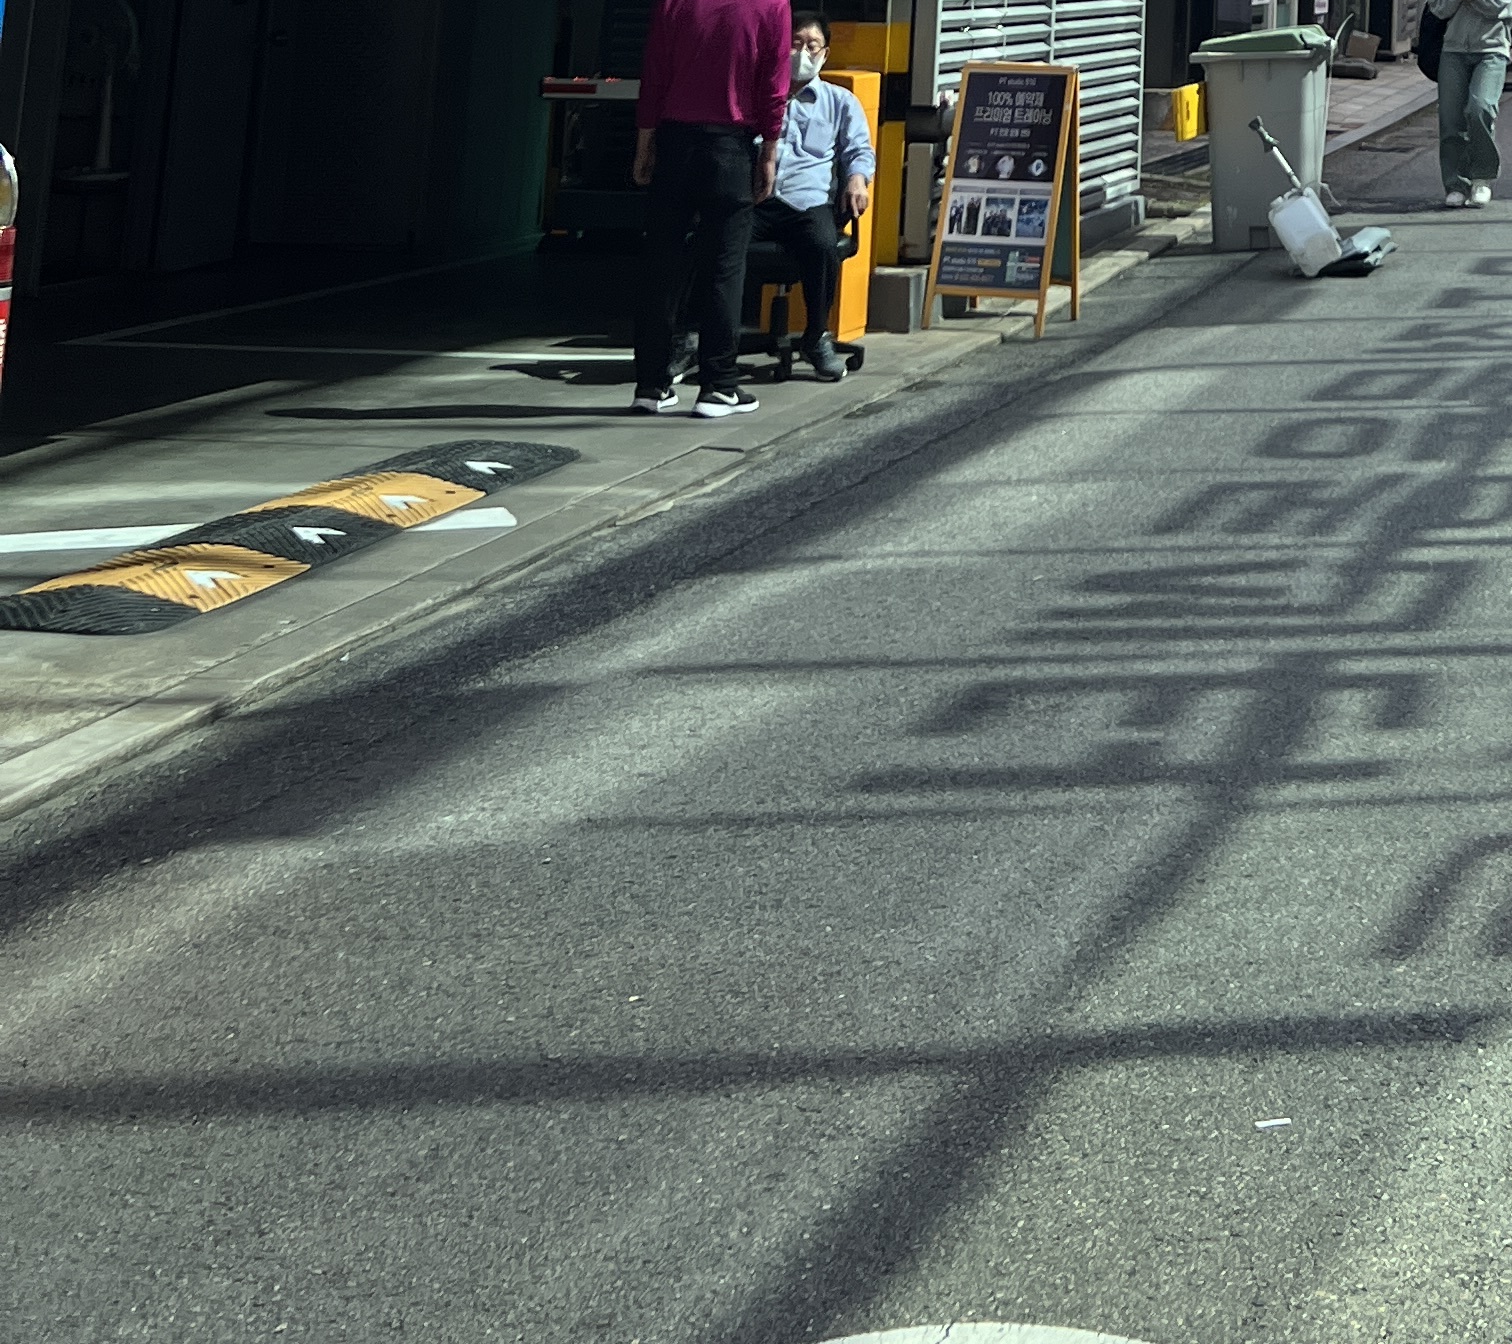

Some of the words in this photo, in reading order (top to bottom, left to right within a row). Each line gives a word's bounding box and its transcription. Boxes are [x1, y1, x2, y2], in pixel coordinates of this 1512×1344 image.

[988, 91, 1013, 106] 100%
[1015, 92, 1044, 107] 예약제
[974, 106, 1012, 123] 프리미엄
[1014, 107, 1053, 125] 트레이닝
